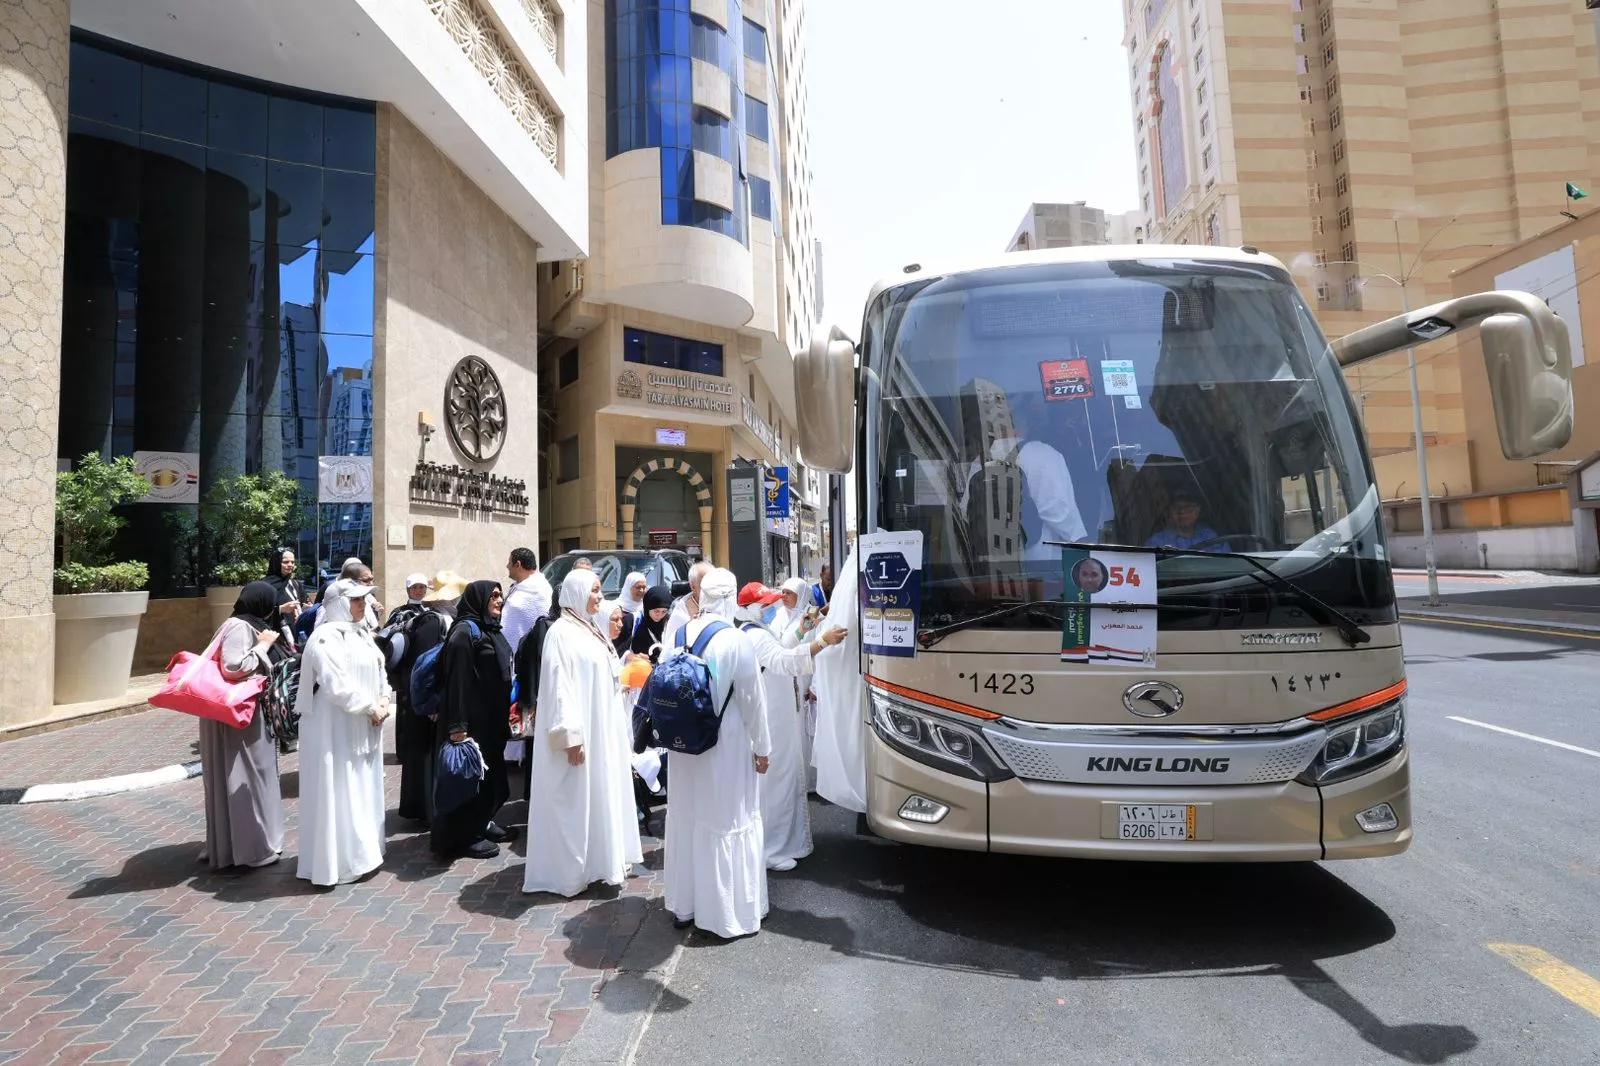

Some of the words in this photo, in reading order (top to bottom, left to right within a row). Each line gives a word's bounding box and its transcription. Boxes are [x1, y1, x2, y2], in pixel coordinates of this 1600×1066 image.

[1054, 385, 1085, 395] 2776
[710, 400, 734, 413] HOTEL
[879, 561, 889, 579] 1
[1109, 566, 1141, 587] 54
[869, 593, 888, 605] واحد
[892, 635, 904, 644] 56
[968, 671, 1035, 696] 1423
[1086, 756, 1152, 772] KING
[1155, 757, 1230, 773] LONG
[1123, 824, 1156, 838] 6206
